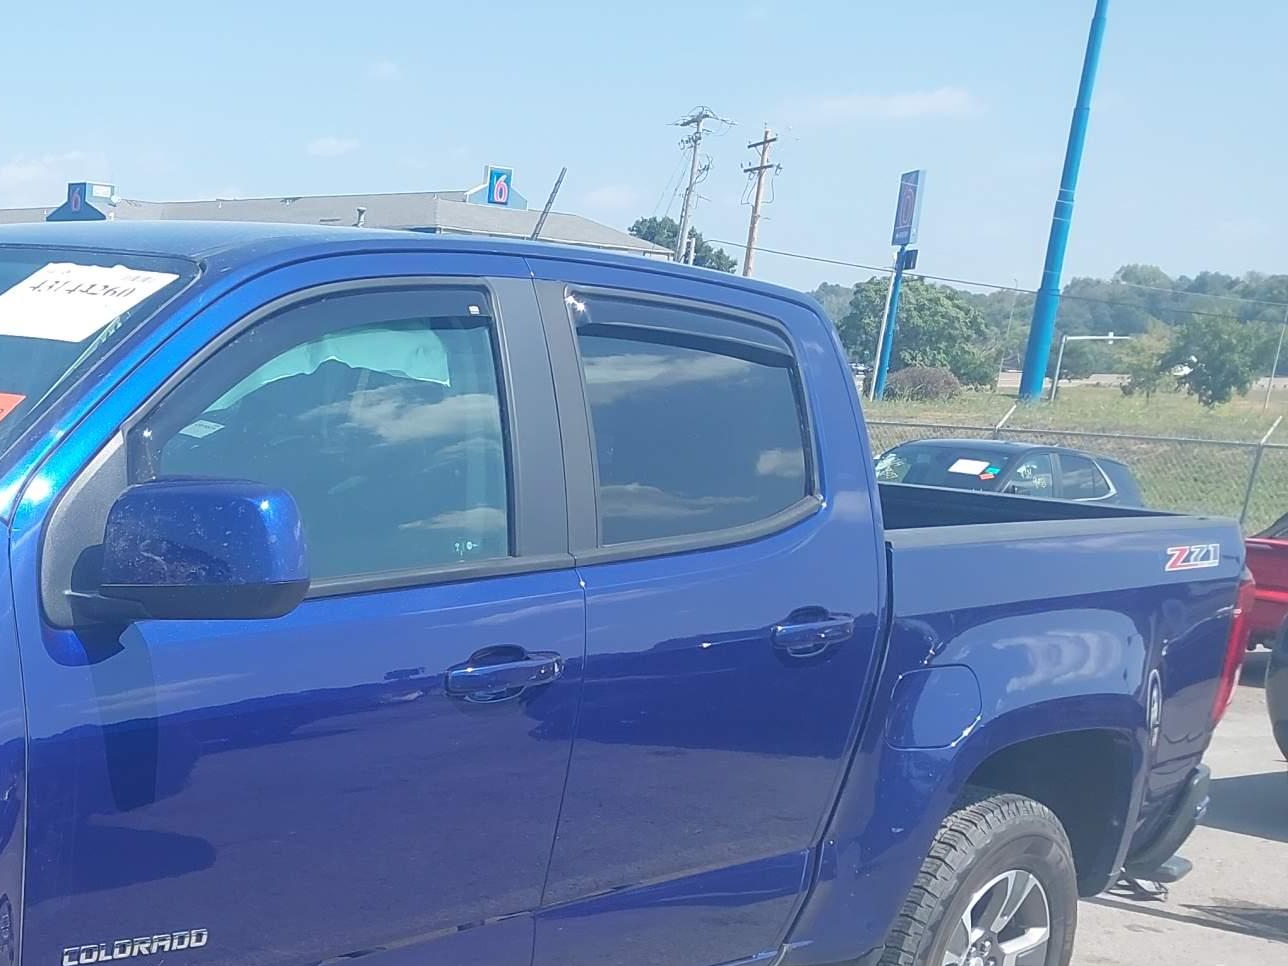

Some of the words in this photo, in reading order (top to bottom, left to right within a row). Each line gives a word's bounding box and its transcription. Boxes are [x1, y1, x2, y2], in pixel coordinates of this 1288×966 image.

[494, 174, 508, 203] 6
[1164, 543, 1221, 572] Z71
[62, 928, 209, 966] COLORADO
